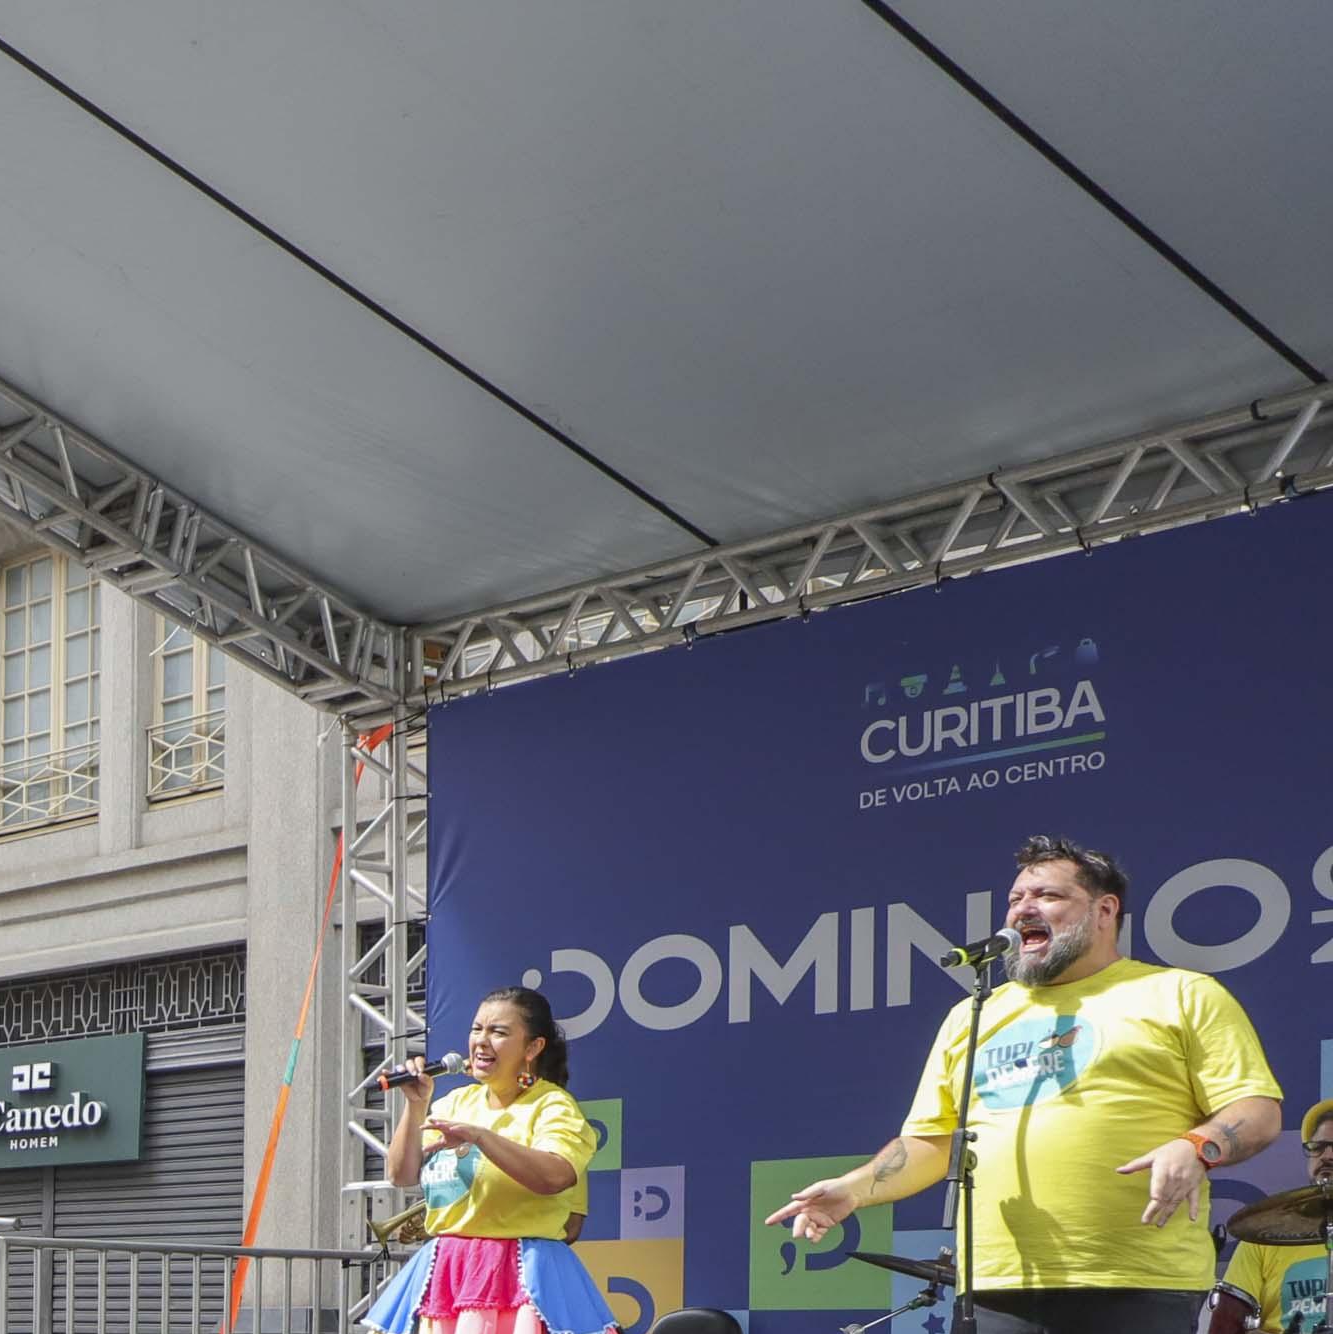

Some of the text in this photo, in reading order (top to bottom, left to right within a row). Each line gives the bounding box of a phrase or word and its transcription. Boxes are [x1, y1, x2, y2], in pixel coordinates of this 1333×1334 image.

[860, 680, 1106, 763] CURITIBA
[859, 751, 1106, 809] DE VOLTA AO CENTRO
[522, 858, 1291, 1040] DOMINO
[10, 1136, 58, 1150] HOMEM
